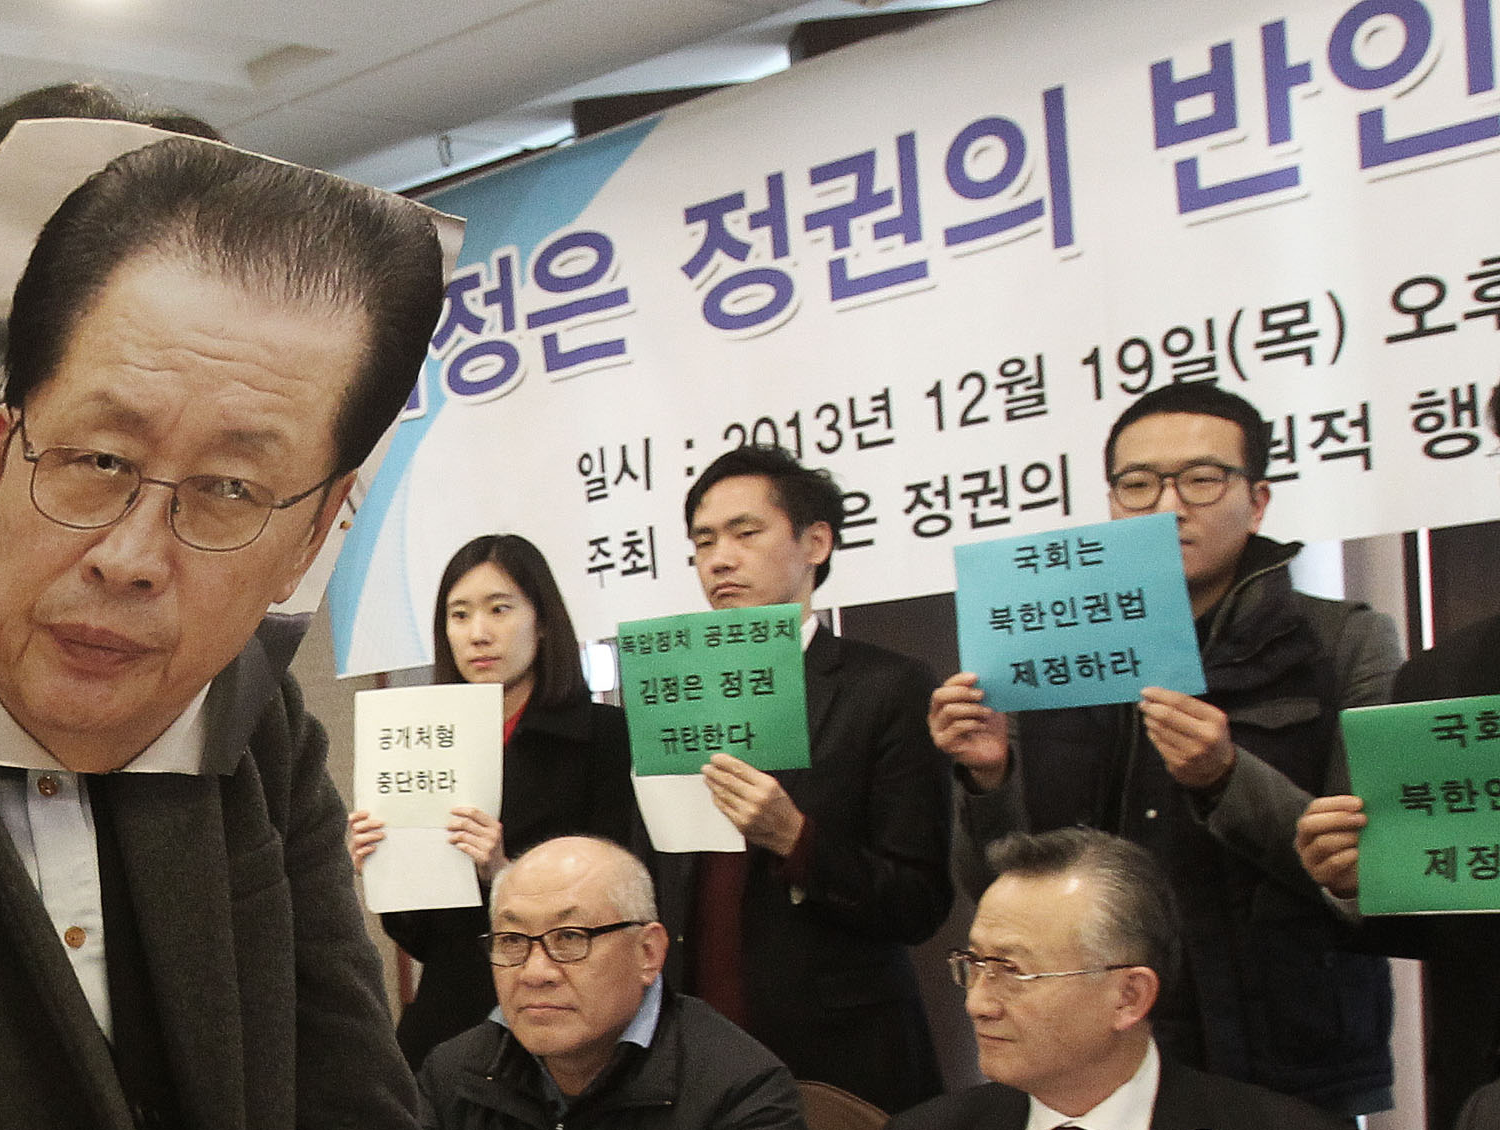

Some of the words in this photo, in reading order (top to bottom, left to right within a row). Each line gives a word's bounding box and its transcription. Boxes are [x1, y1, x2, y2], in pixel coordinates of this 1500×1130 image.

[406, 230, 633, 411] 정은
[681, 85, 1075, 332] 정권의
[578, 437, 652, 503] 일시
[723, 388, 895, 458] 2013년
[925, 353, 1049, 431] 12월
[1081, 290, 1346, 400] 19일(목)
[587, 526, 657, 588] 주최
[904, 454, 1071, 538] 정권의
[1014, 538, 1105, 573] 국회는
[989, 588, 1147, 635] 북한인권법
[704, 618, 796, 647] 공포정치
[640, 675, 703, 704] 김정은
[720, 667, 775, 698] 정권
[1010, 648, 1142, 688] 제정하라
[379, 724, 455, 750] 공개처형
[661, 722, 755, 755] 규탄한다
[378, 769, 457, 794] 중단하라
